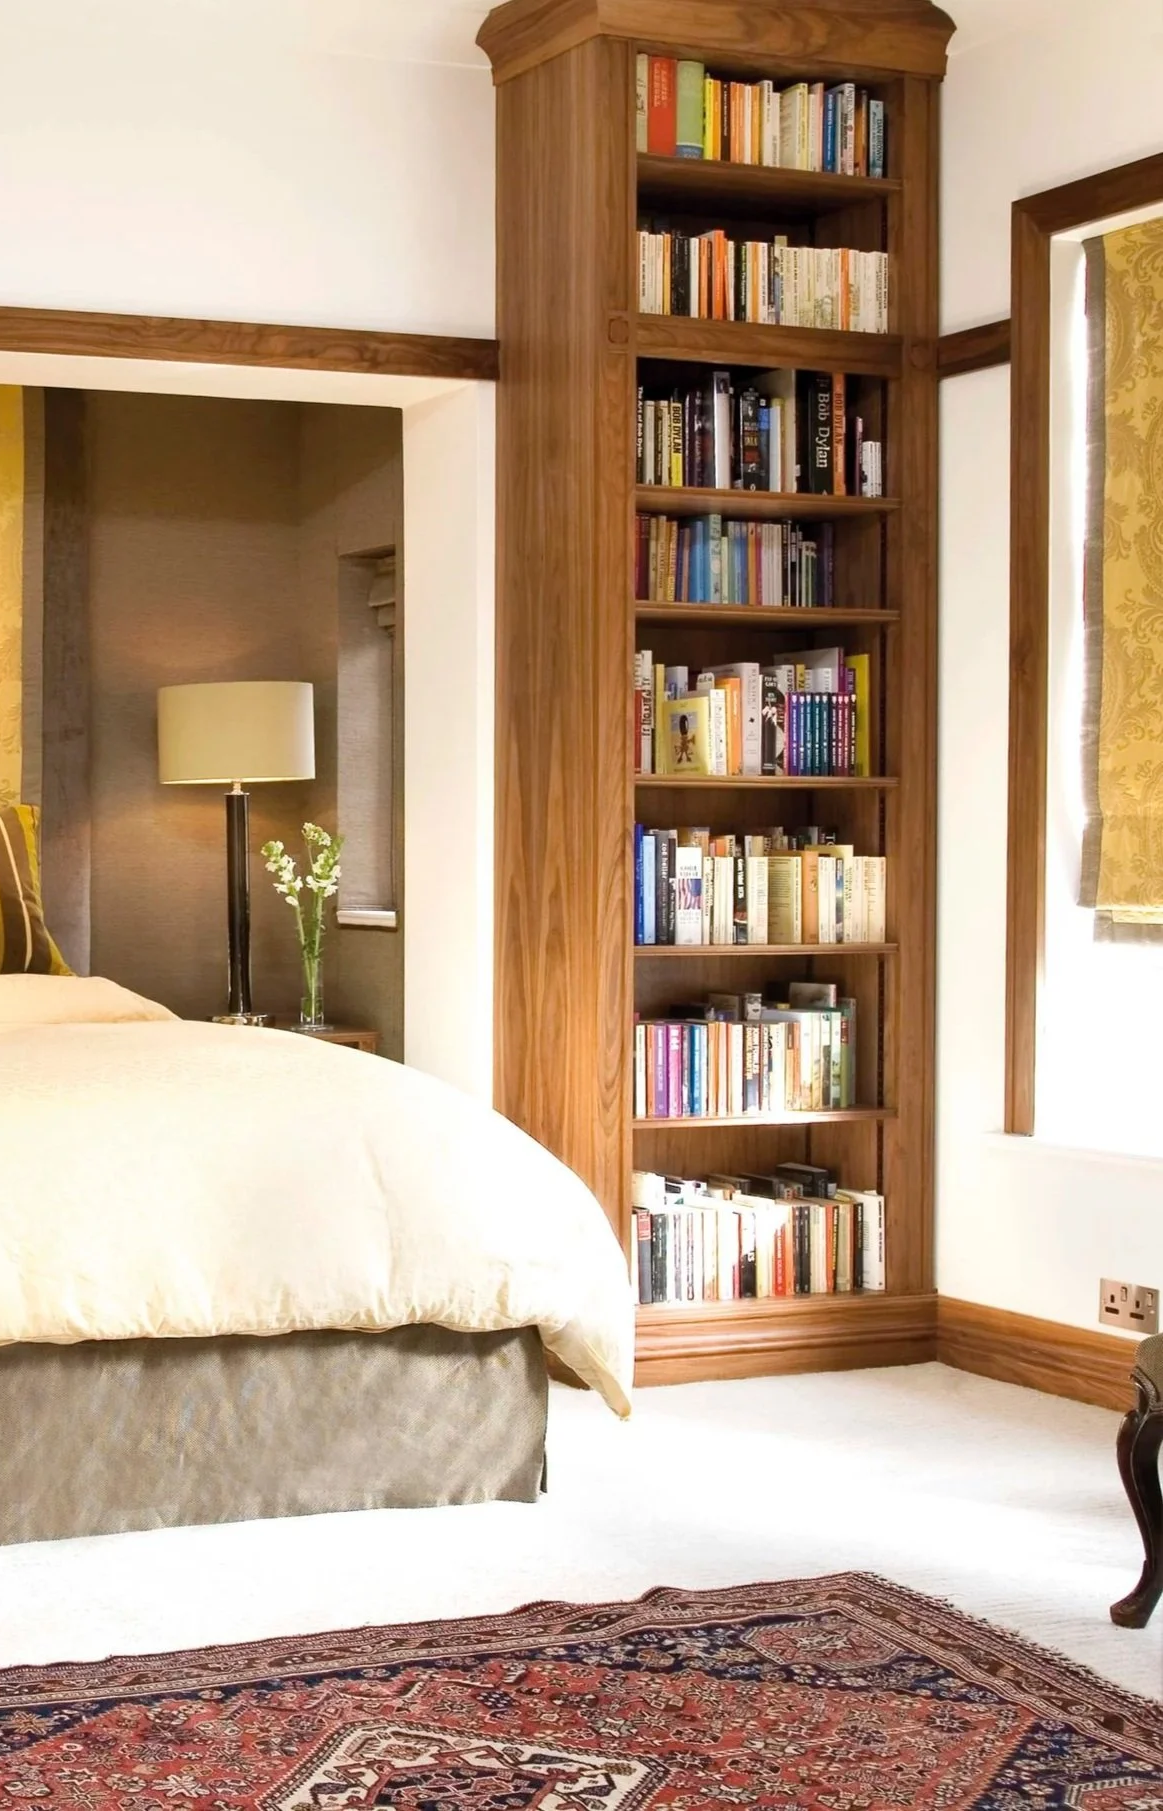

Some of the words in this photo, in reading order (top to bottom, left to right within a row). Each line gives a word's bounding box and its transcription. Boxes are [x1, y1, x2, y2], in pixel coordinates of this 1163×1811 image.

[672, 405, 681, 424] BOB
[817, 392, 830, 421] Bob
[834, 392, 844, 412] BOB
[672, 425, 681, 455] DYLAN
[834, 413, 844, 446] DYLAN
[636, 437, 644, 458] Dylan
[815, 426, 831, 469] Dylan
